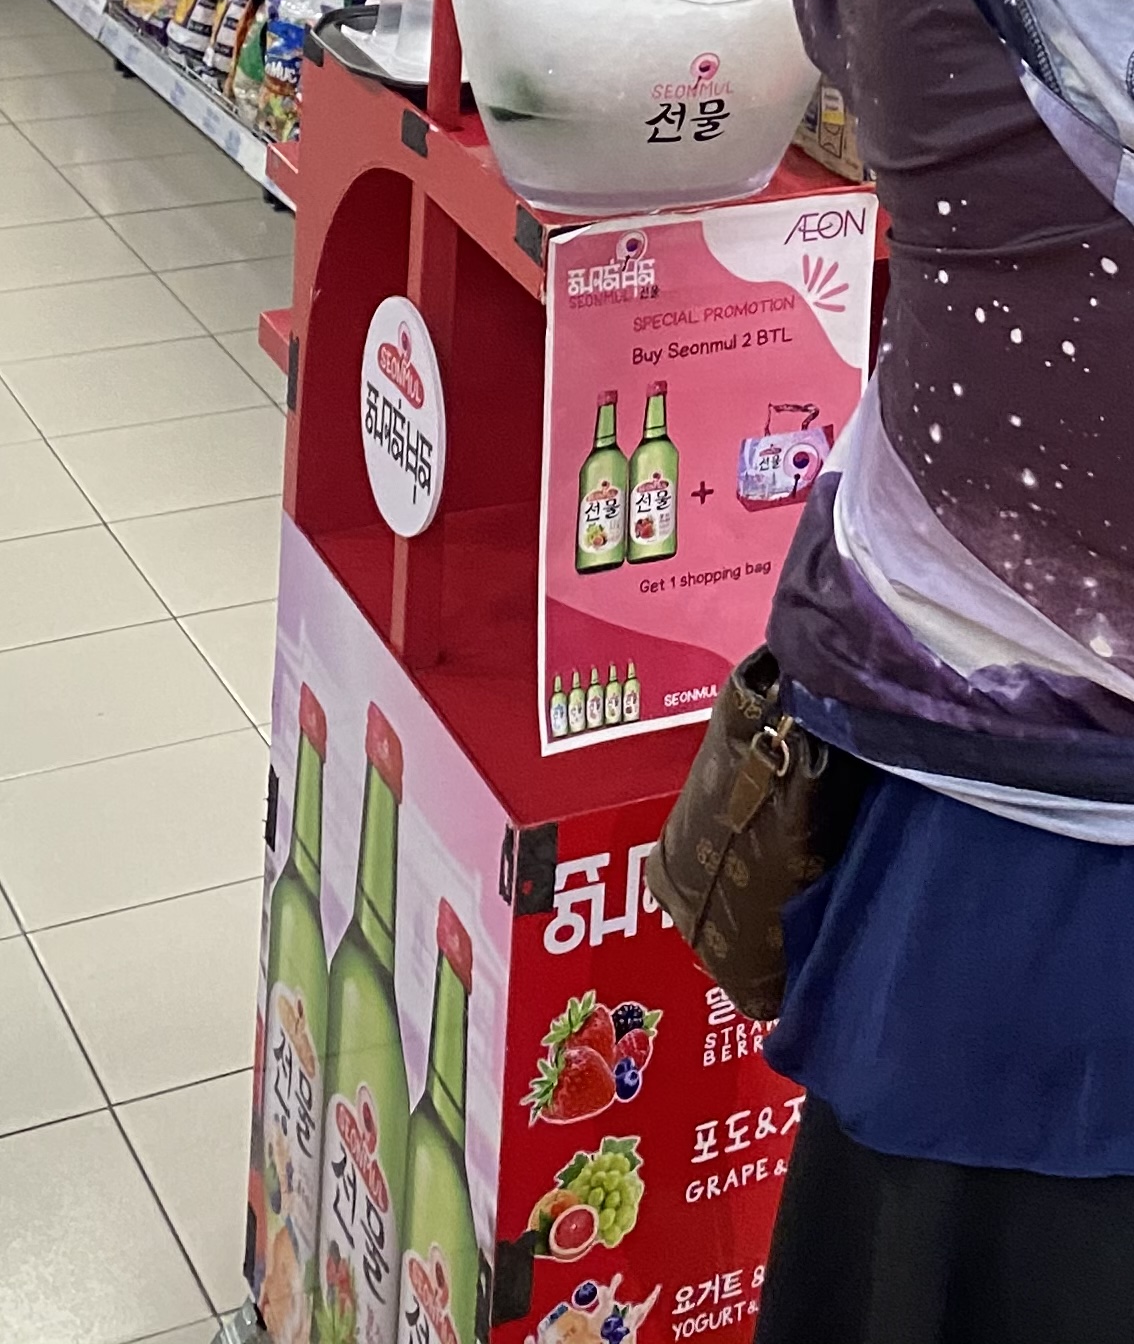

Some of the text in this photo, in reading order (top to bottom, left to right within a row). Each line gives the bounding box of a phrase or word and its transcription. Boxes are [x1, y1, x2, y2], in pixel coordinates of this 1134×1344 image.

[651, 80, 734, 100] SEONMUL
[633, 295, 795, 333] SPECIAL PROMOTION
[632, 326, 793, 365] Buy Seonmul 2 BTL
[639, 560, 772, 594] Get 1 shopping bag
[664, 684, 719, 707] SEONMUL
[703, 1034, 764, 1066] BERR
[686, 1158, 788, 1203] GRAPE &
[672, 1269, 743, 1314] 요거트
[672, 1301, 746, 1343] YOGURT
